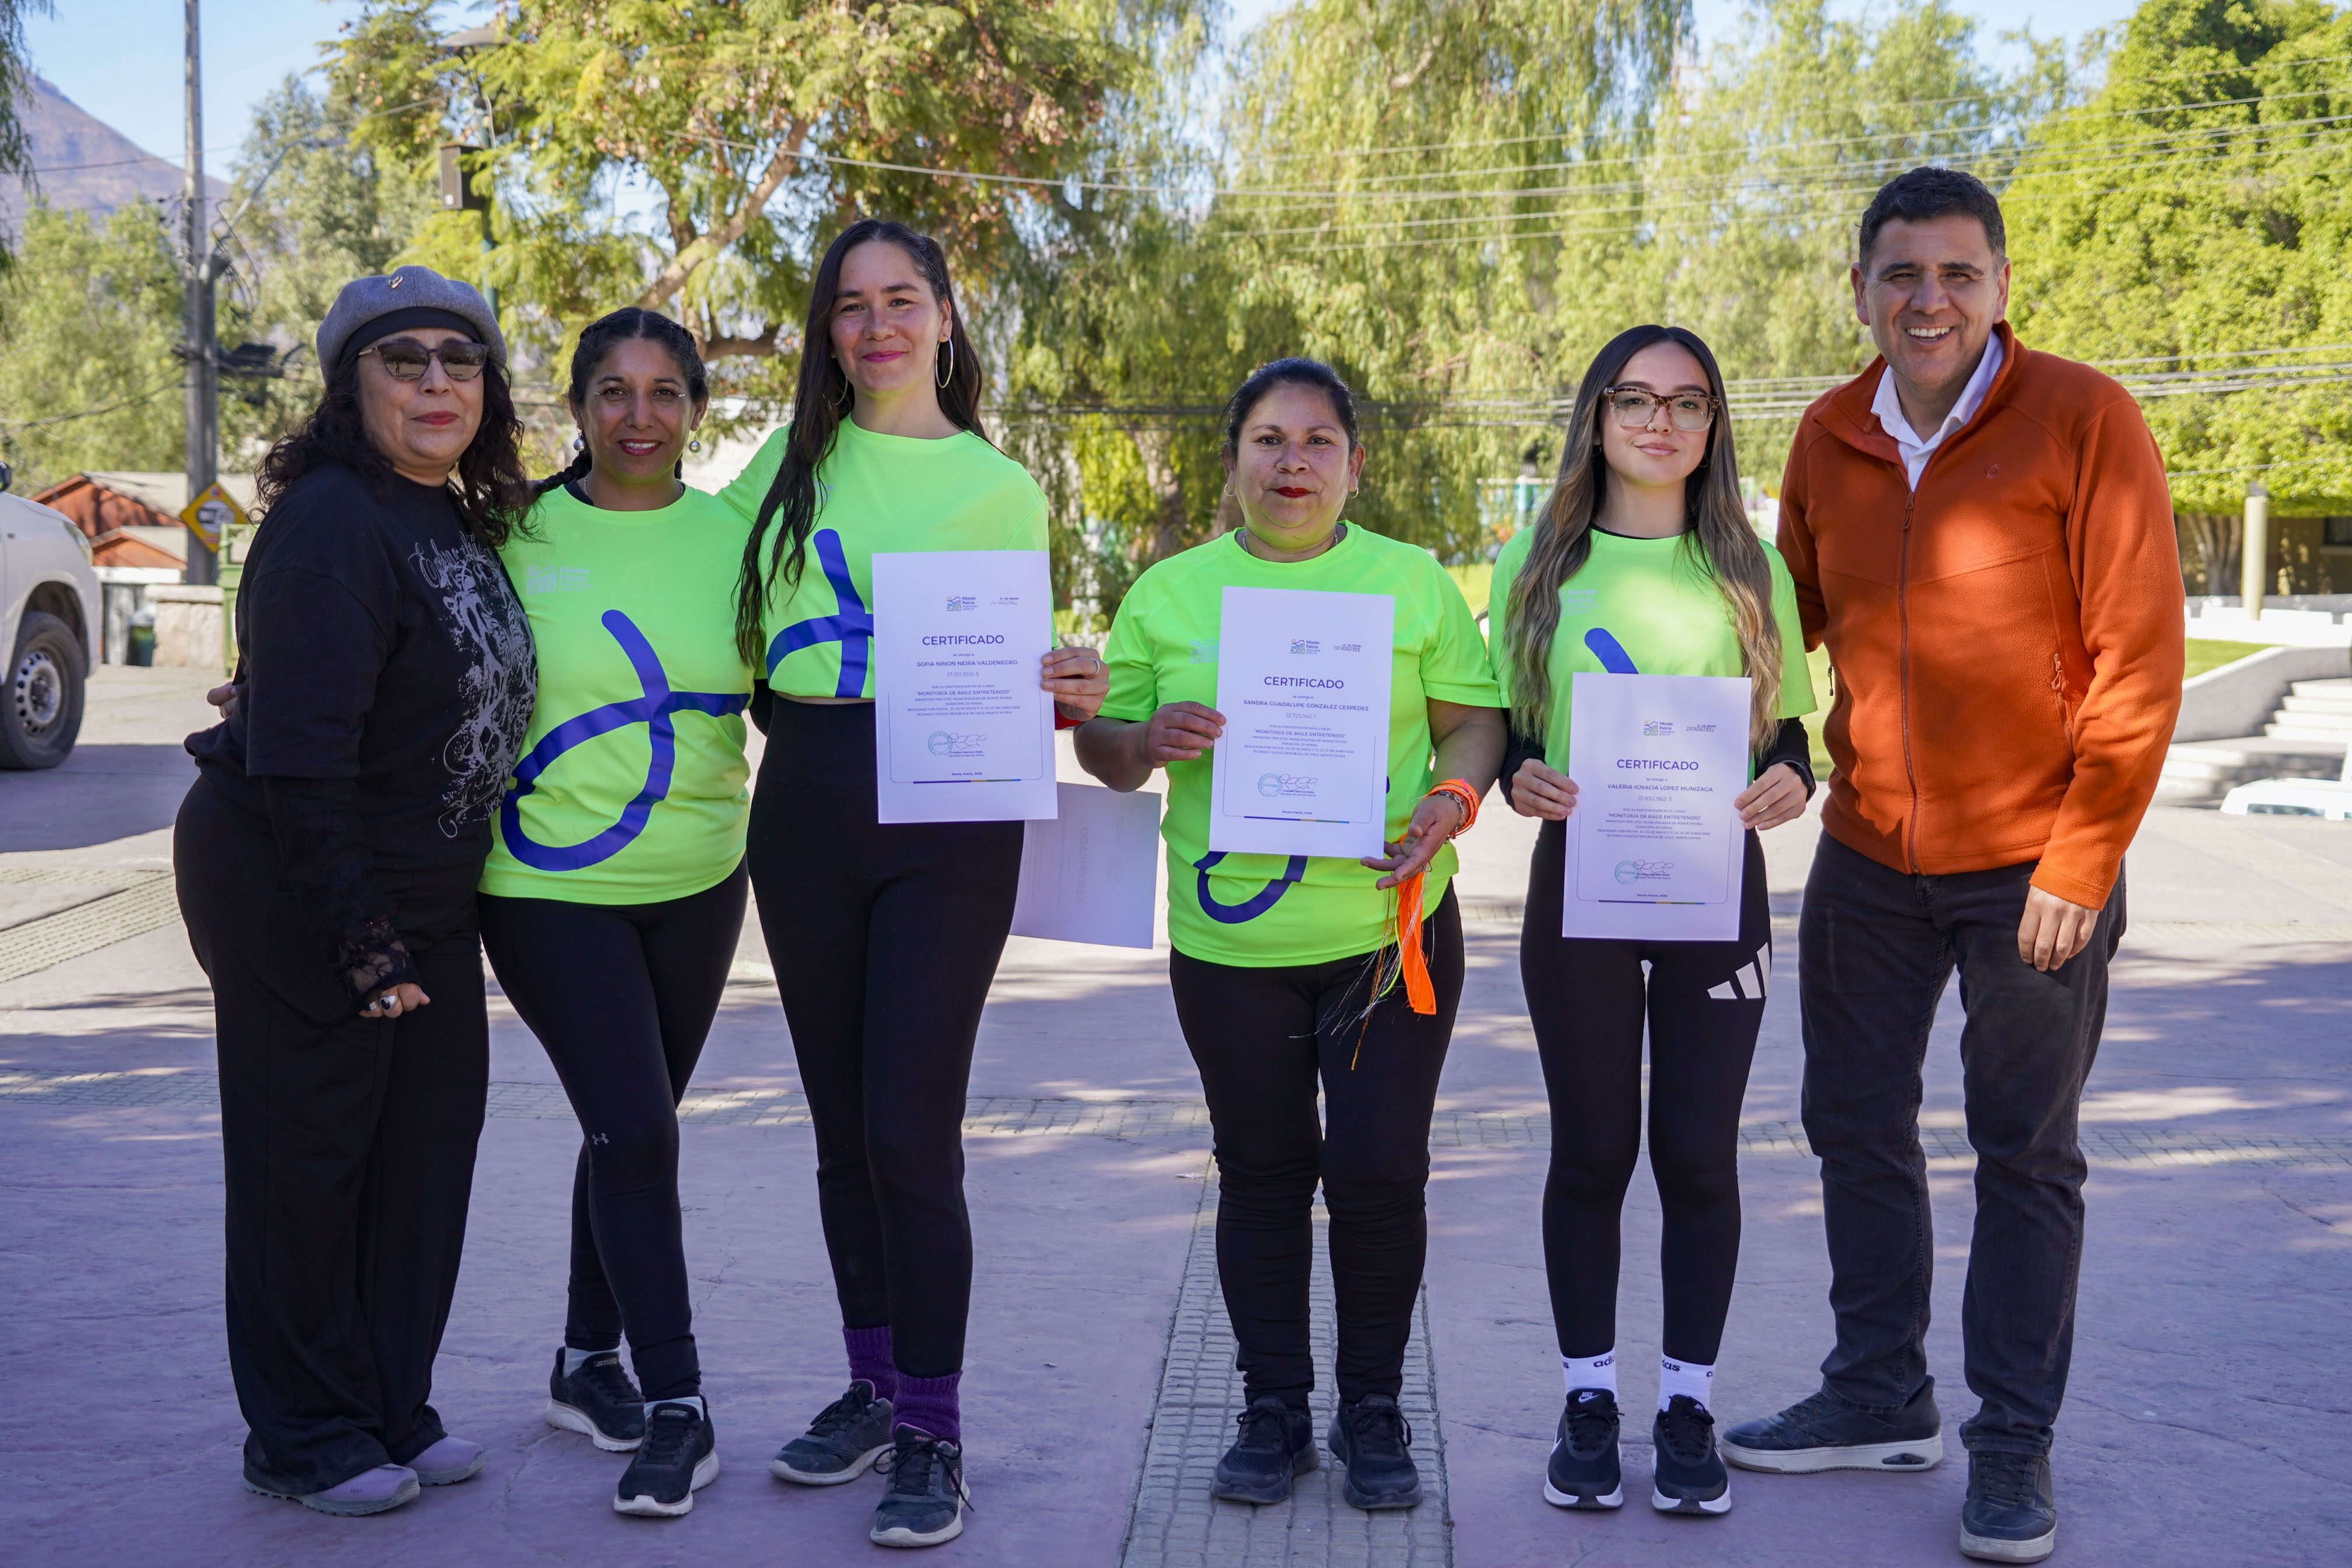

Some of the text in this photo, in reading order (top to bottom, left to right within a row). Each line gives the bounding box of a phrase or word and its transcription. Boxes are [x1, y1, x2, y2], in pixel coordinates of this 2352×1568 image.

[922, 635, 1004, 645] CERTIFICADO
[1264, 676, 1344, 689] CERTIFICADO
[1617, 760, 1699, 770] CERTIFICADO
